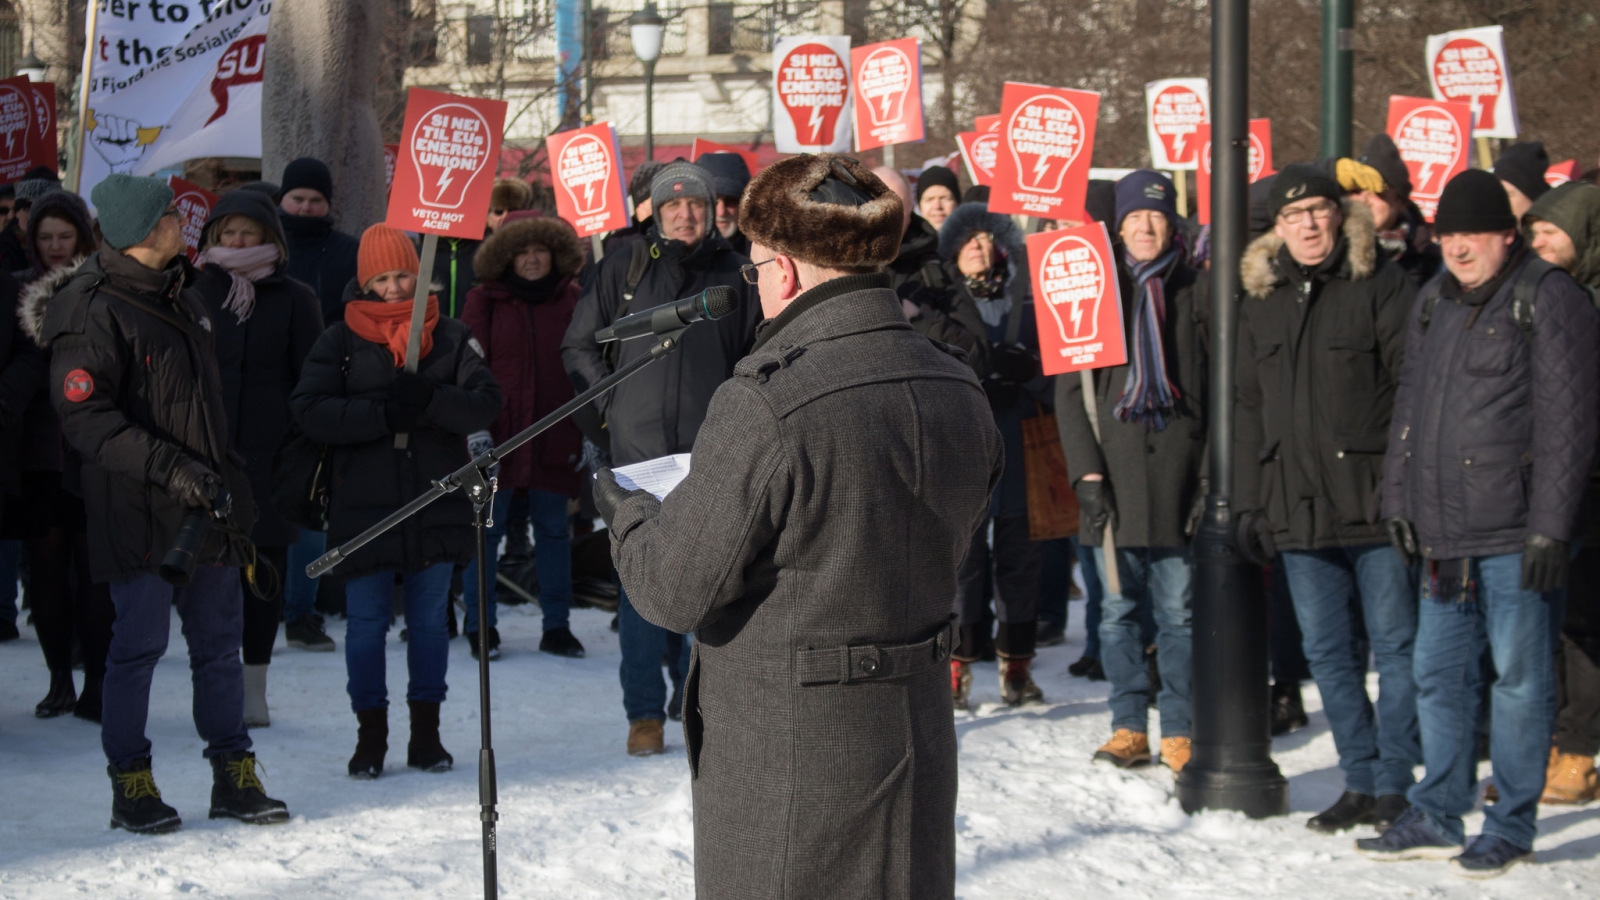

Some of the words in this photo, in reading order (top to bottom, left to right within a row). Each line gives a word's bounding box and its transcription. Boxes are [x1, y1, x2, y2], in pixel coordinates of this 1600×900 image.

[148, 0, 189, 23] to
[216, 43, 266, 80] SU
[790, 54, 808, 67] SI
[809, 54, 838, 67] NEI
[783, 68, 811, 80] TIL
[781, 81, 847, 93] ENERGI-
[786, 94, 843, 107] UNION!
[1025, 105, 1043, 118] SI
[1044, 107, 1073, 122] NEI
[431, 114, 449, 128] SI
[451, 117, 481, 132] NEI
[1017, 116, 1044, 130] TIL
[422, 125, 449, 141] TIL
[452, 130, 484, 145] EUs
[1012, 128, 1079, 146] ENERGI-
[415, 138, 484, 158] ENERGI-
[1016, 141, 1073, 158] UNION!
[419, 152, 477, 171] UNION!
[1012, 192, 1039, 203] VETO
[1040, 196, 1064, 206] MOT
[412, 207, 439, 219] VETO
[441, 212, 465, 223] MOT
[1022, 203, 1050, 213] ACER
[422, 219, 450, 230] ACER
[1049, 251, 1064, 265] SI
[1065, 247, 1090, 263] NEI
[1046, 264, 1068, 279] TIL
[1045, 272, 1101, 293] ENERGI-
[1050, 285, 1099, 305] UNION!
[1059, 346, 1083, 358] VETO
[1083, 342, 1103, 352] MOT
[1071, 353, 1095, 365] ACER
